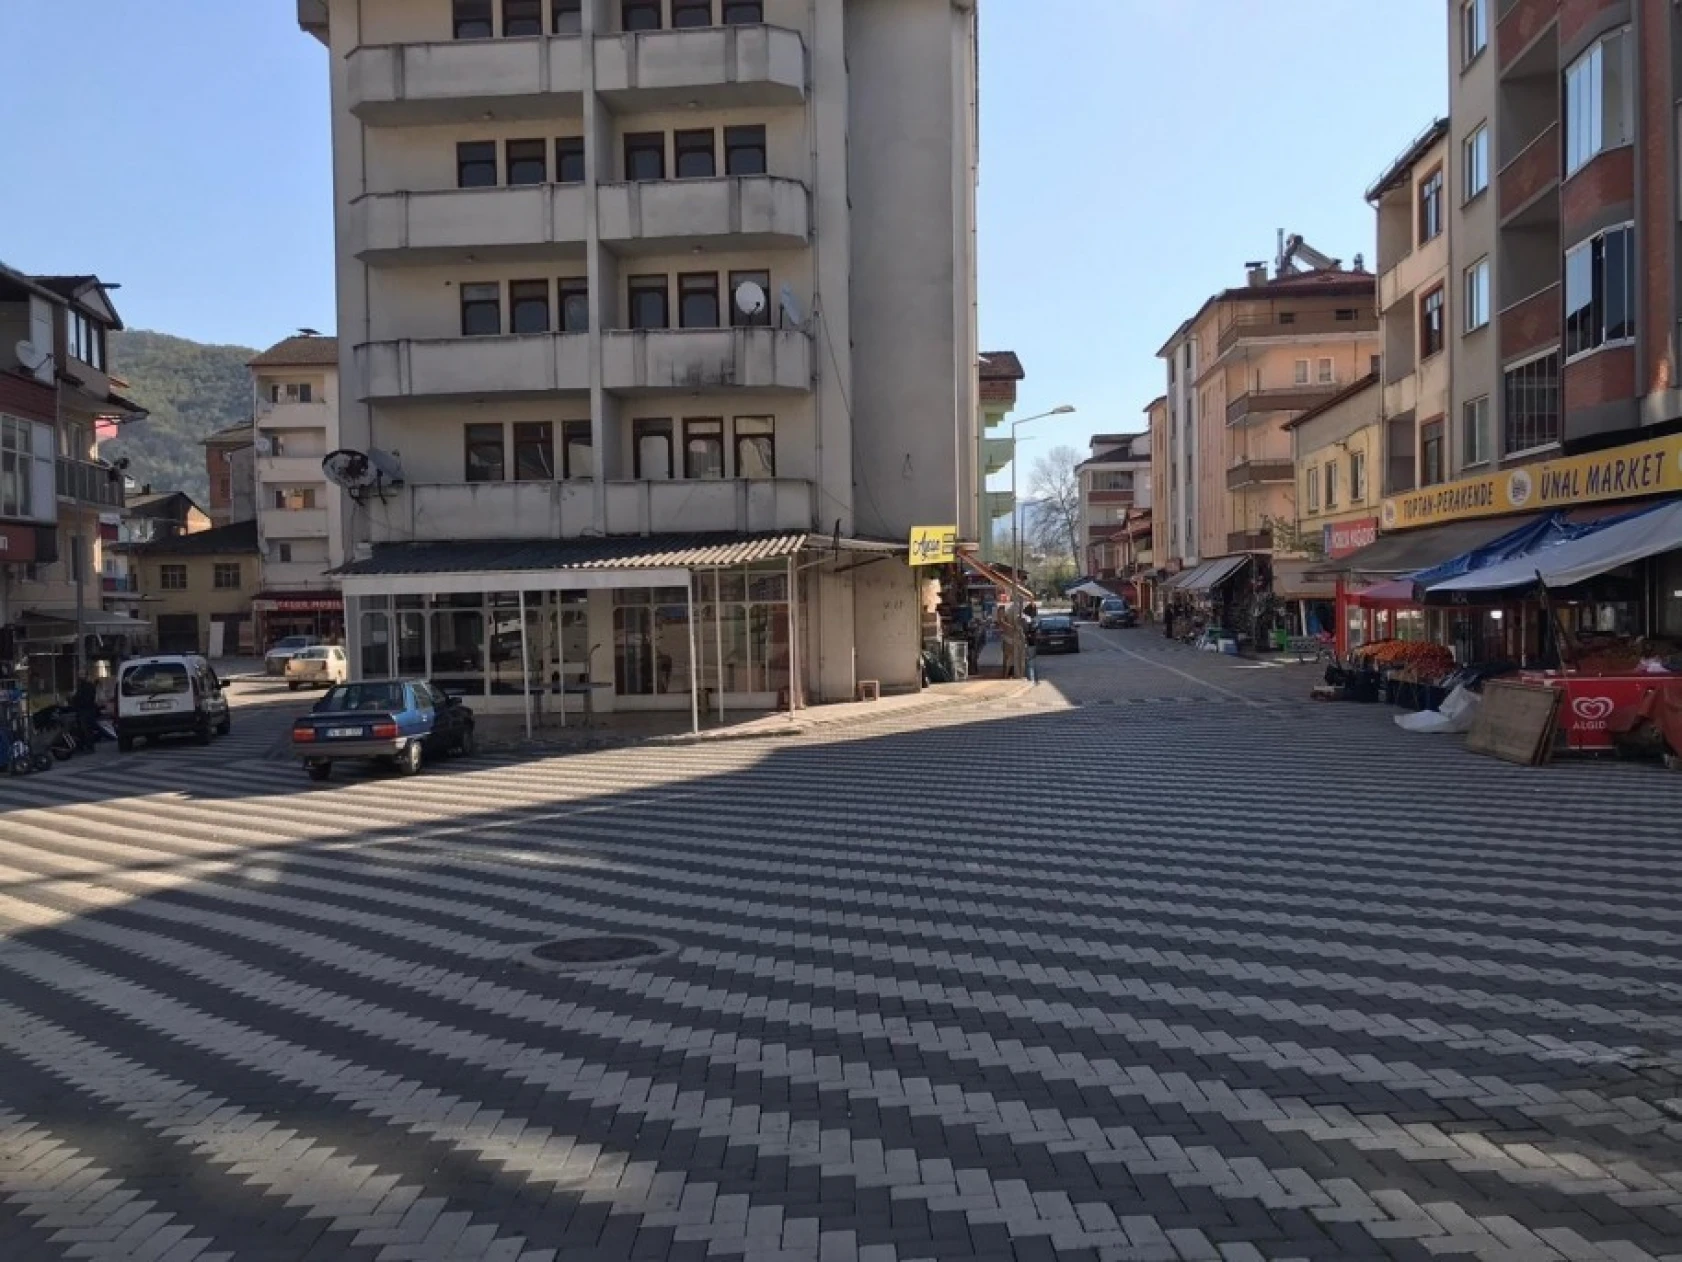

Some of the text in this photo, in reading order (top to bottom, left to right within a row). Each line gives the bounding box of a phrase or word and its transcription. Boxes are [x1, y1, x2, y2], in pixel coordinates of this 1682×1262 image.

[1541, 466, 1579, 500] ÜNAL
[1586, 451, 1665, 495] MARKET
[1404, 482, 1493, 520] TOPTAN-PERAKENDE
[1573, 720, 1607, 729] ALGID
